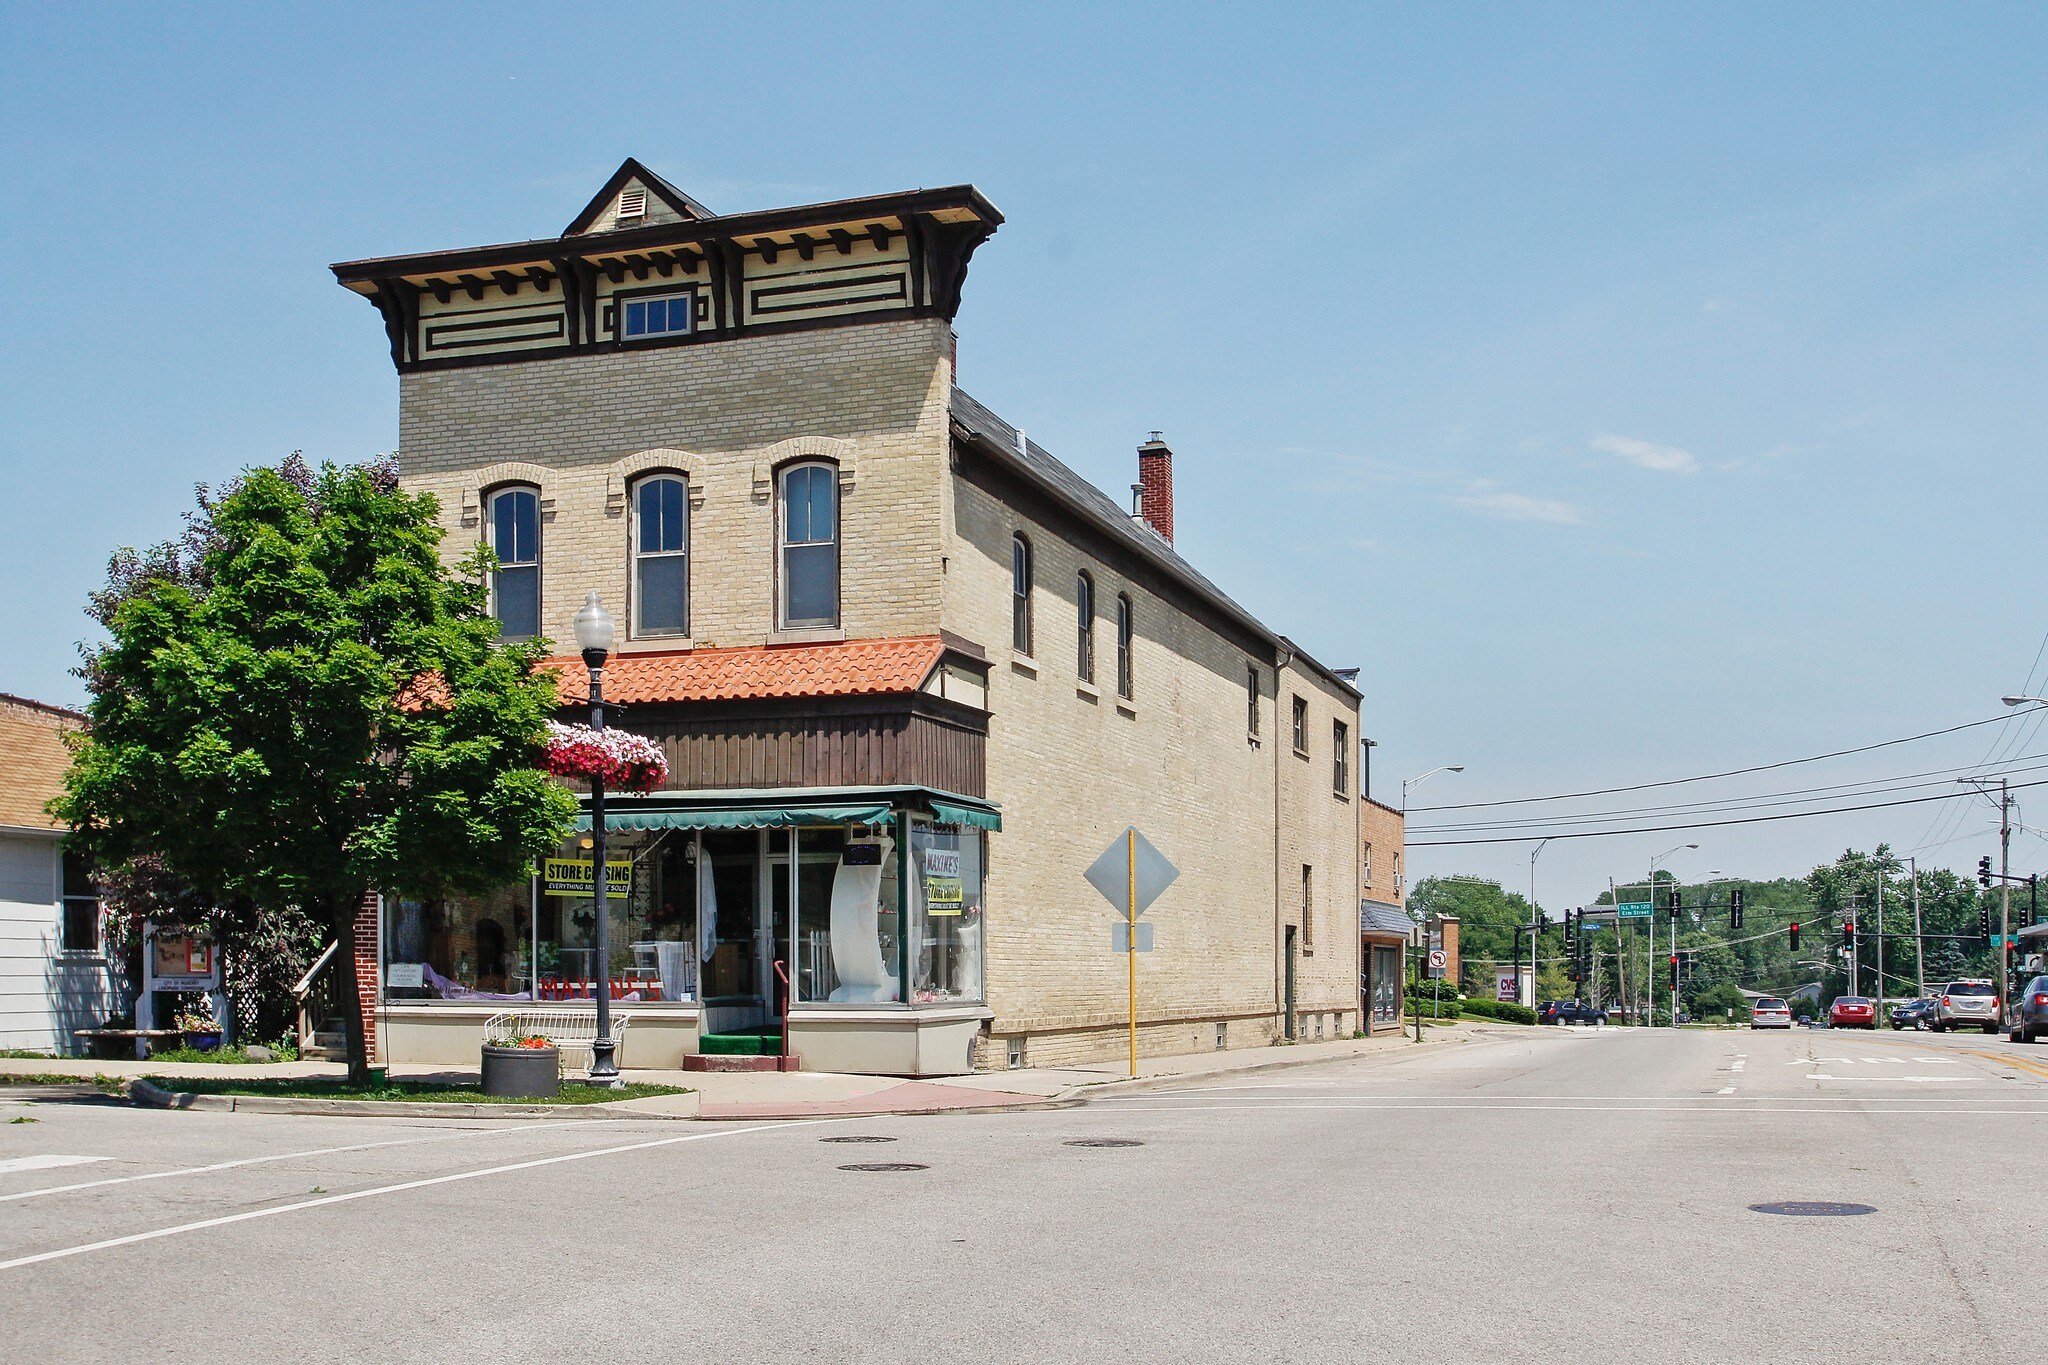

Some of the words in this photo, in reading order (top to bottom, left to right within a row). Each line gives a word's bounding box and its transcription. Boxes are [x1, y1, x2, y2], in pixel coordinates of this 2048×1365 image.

[548, 864, 582, 880] STORE
[548, 883, 584, 891] EVERYTHING
[539, 976, 660, 1002] MAXNES
[1500, 978, 1516, 991] CVS
